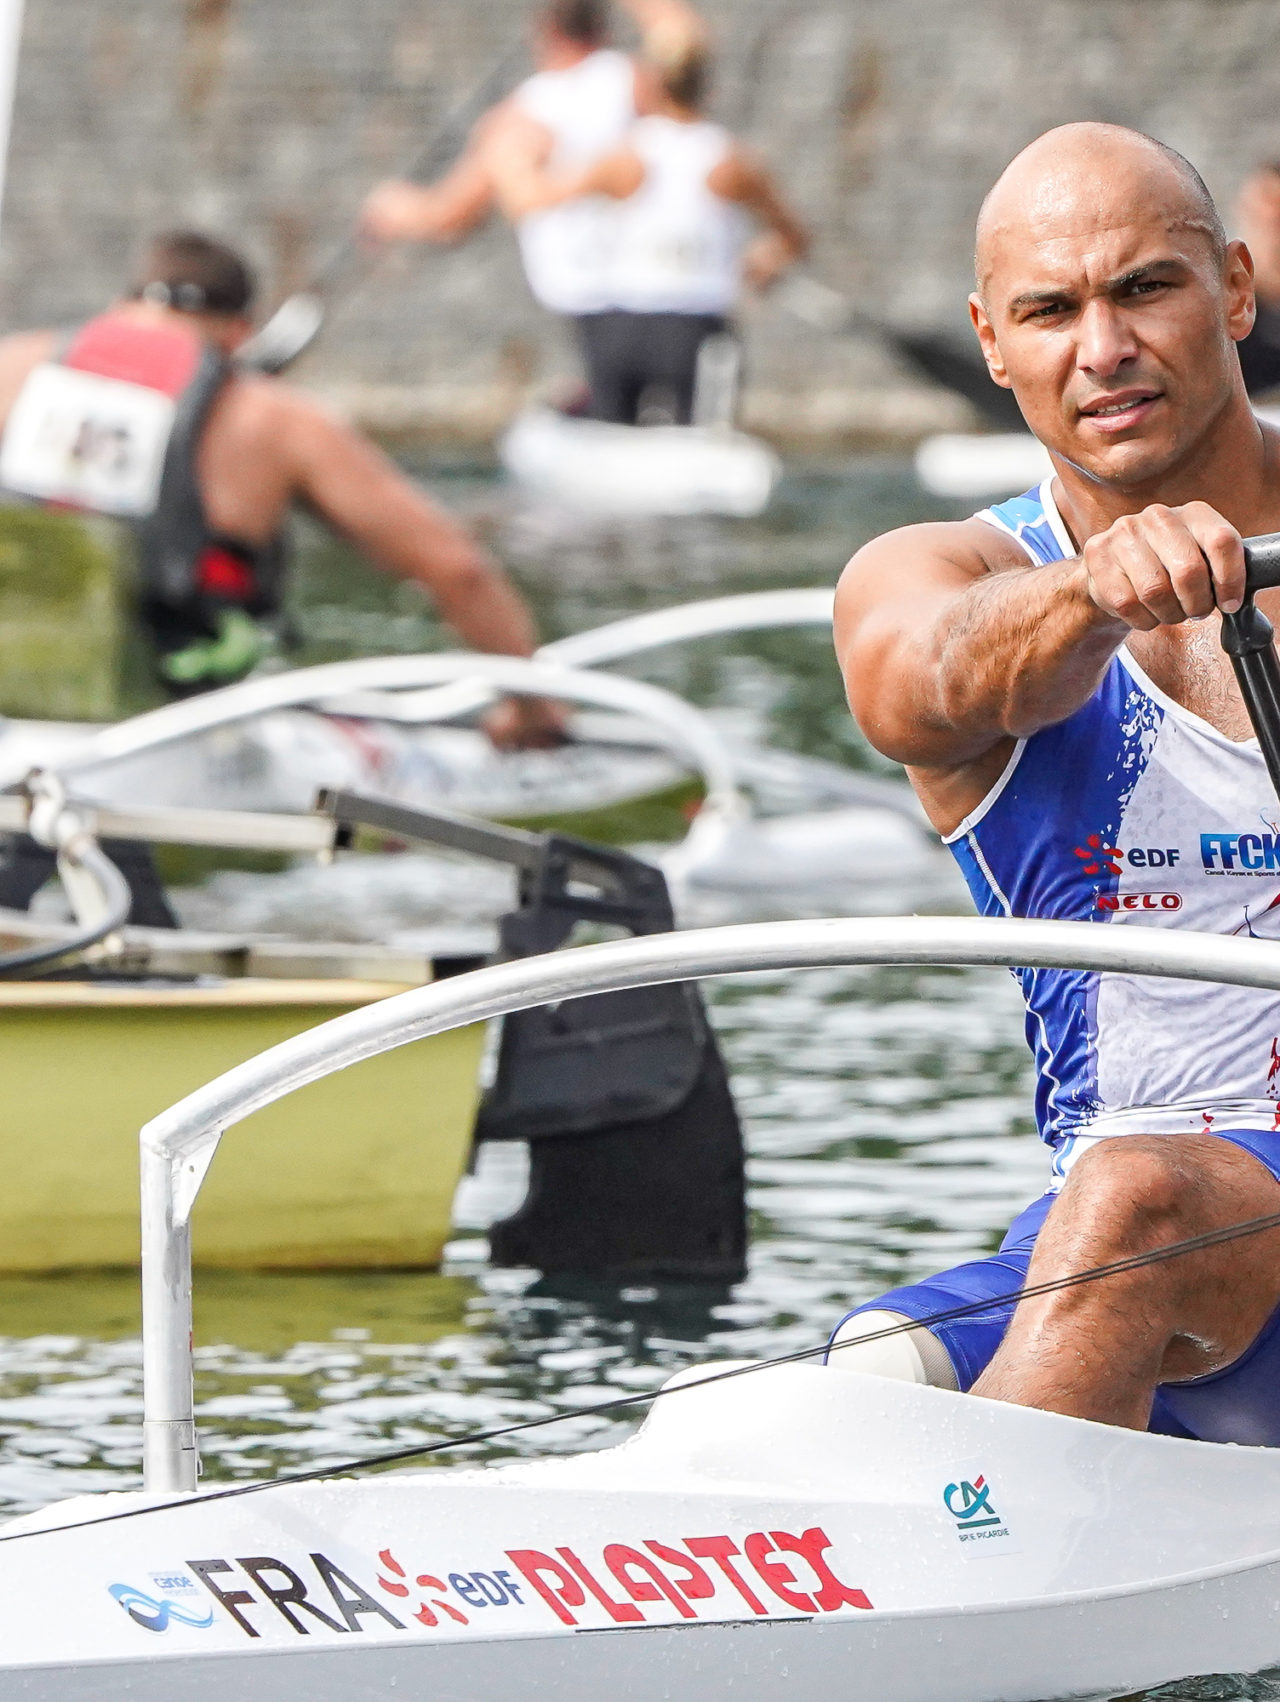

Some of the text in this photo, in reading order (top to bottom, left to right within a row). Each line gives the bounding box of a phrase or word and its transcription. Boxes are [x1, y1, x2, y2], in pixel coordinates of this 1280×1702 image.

[1097, 894, 1181, 910] NELO
[976, 1528, 1010, 1539] PICARDIE
[185, 1553, 407, 1637] FRA
